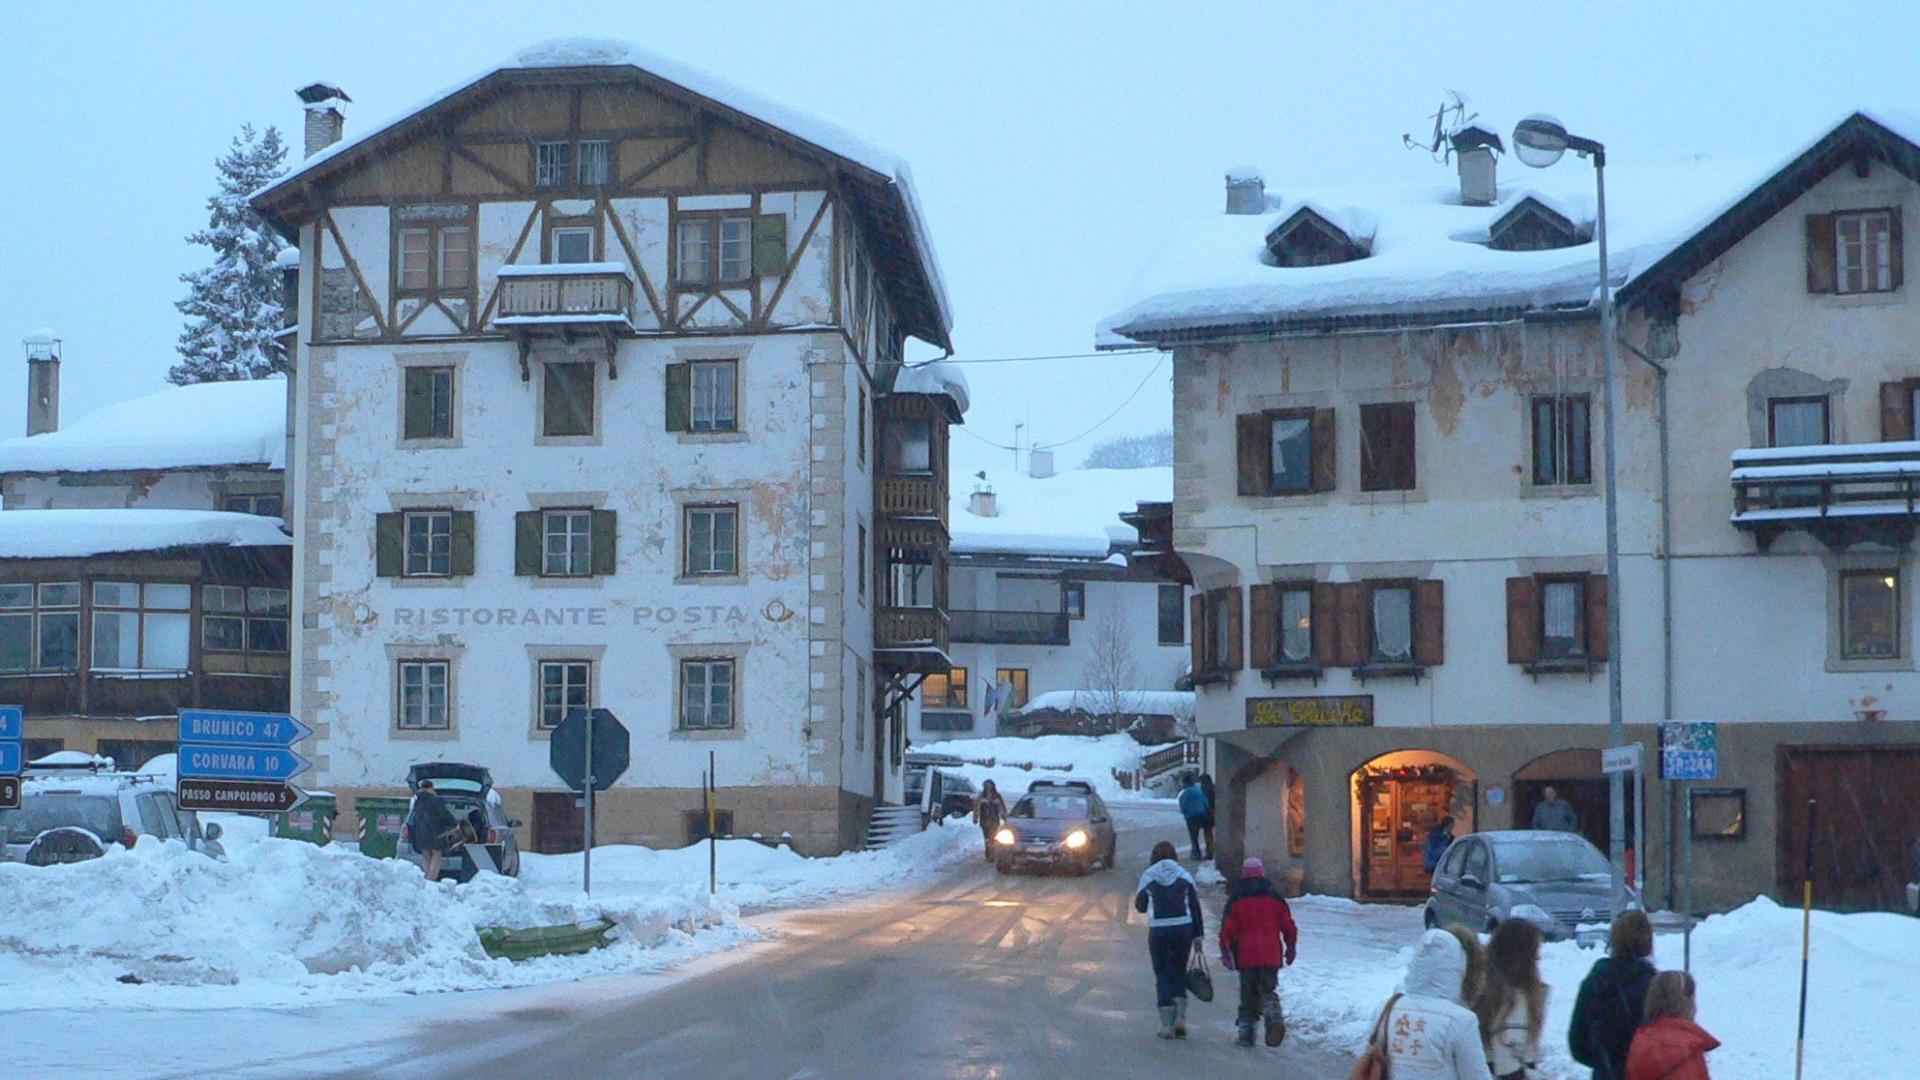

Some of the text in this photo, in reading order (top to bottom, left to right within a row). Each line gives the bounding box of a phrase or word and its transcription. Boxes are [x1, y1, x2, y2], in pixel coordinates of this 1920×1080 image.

[394, 605, 747, 627] RISTORANTE POSTA
[1253, 701, 1283, 725] Le
[192, 718, 280, 738] BRUNICO 47
[192, 753, 279, 770] CORVARA 10
[5, 786, 13, 799] 9
[181, 788, 287, 804] PASSO CAMPOLONGO 5
